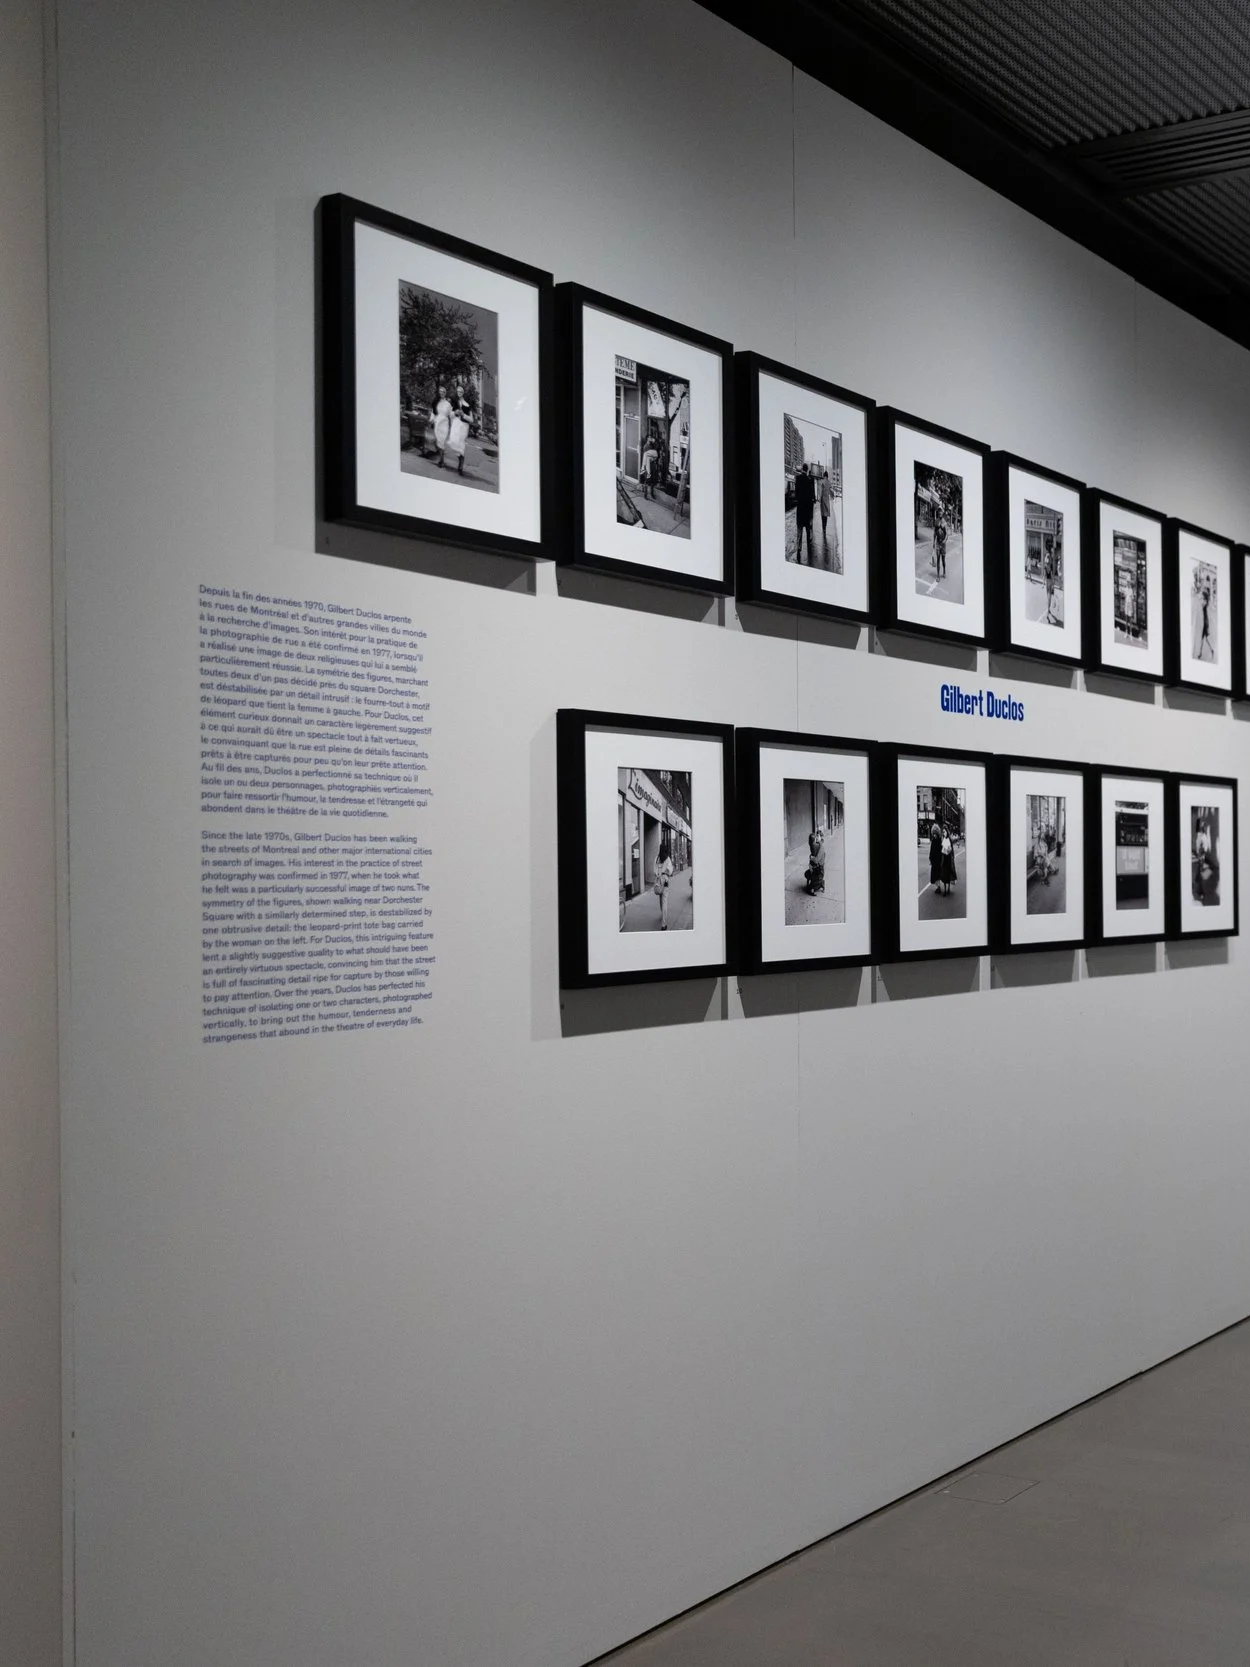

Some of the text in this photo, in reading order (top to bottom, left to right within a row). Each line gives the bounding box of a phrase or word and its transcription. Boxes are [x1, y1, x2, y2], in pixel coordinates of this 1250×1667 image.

[200, 585, 411, 623] Depuis la fin des années 1970, Gilbert Duclos arpente
[200, 599, 427, 637] les rues de Montréal et d'autres grandes villes du monde
[941, 684, 1024, 721] Gilbert Duclos
[202, 845, 216, 853] the
[218, 845, 249, 853] streets
[301, 846, 316, 854] and
[318, 846, 339, 854] other
[341, 847, 362, 856] major
[413, 847, 432, 855] cities
[245, 832, 262, 840] late
[264, 832, 291, 842] 1970s,
[323, 833, 351, 841] Duclos
[368, 834, 387, 842] been
[389, 834, 417, 844] walking
